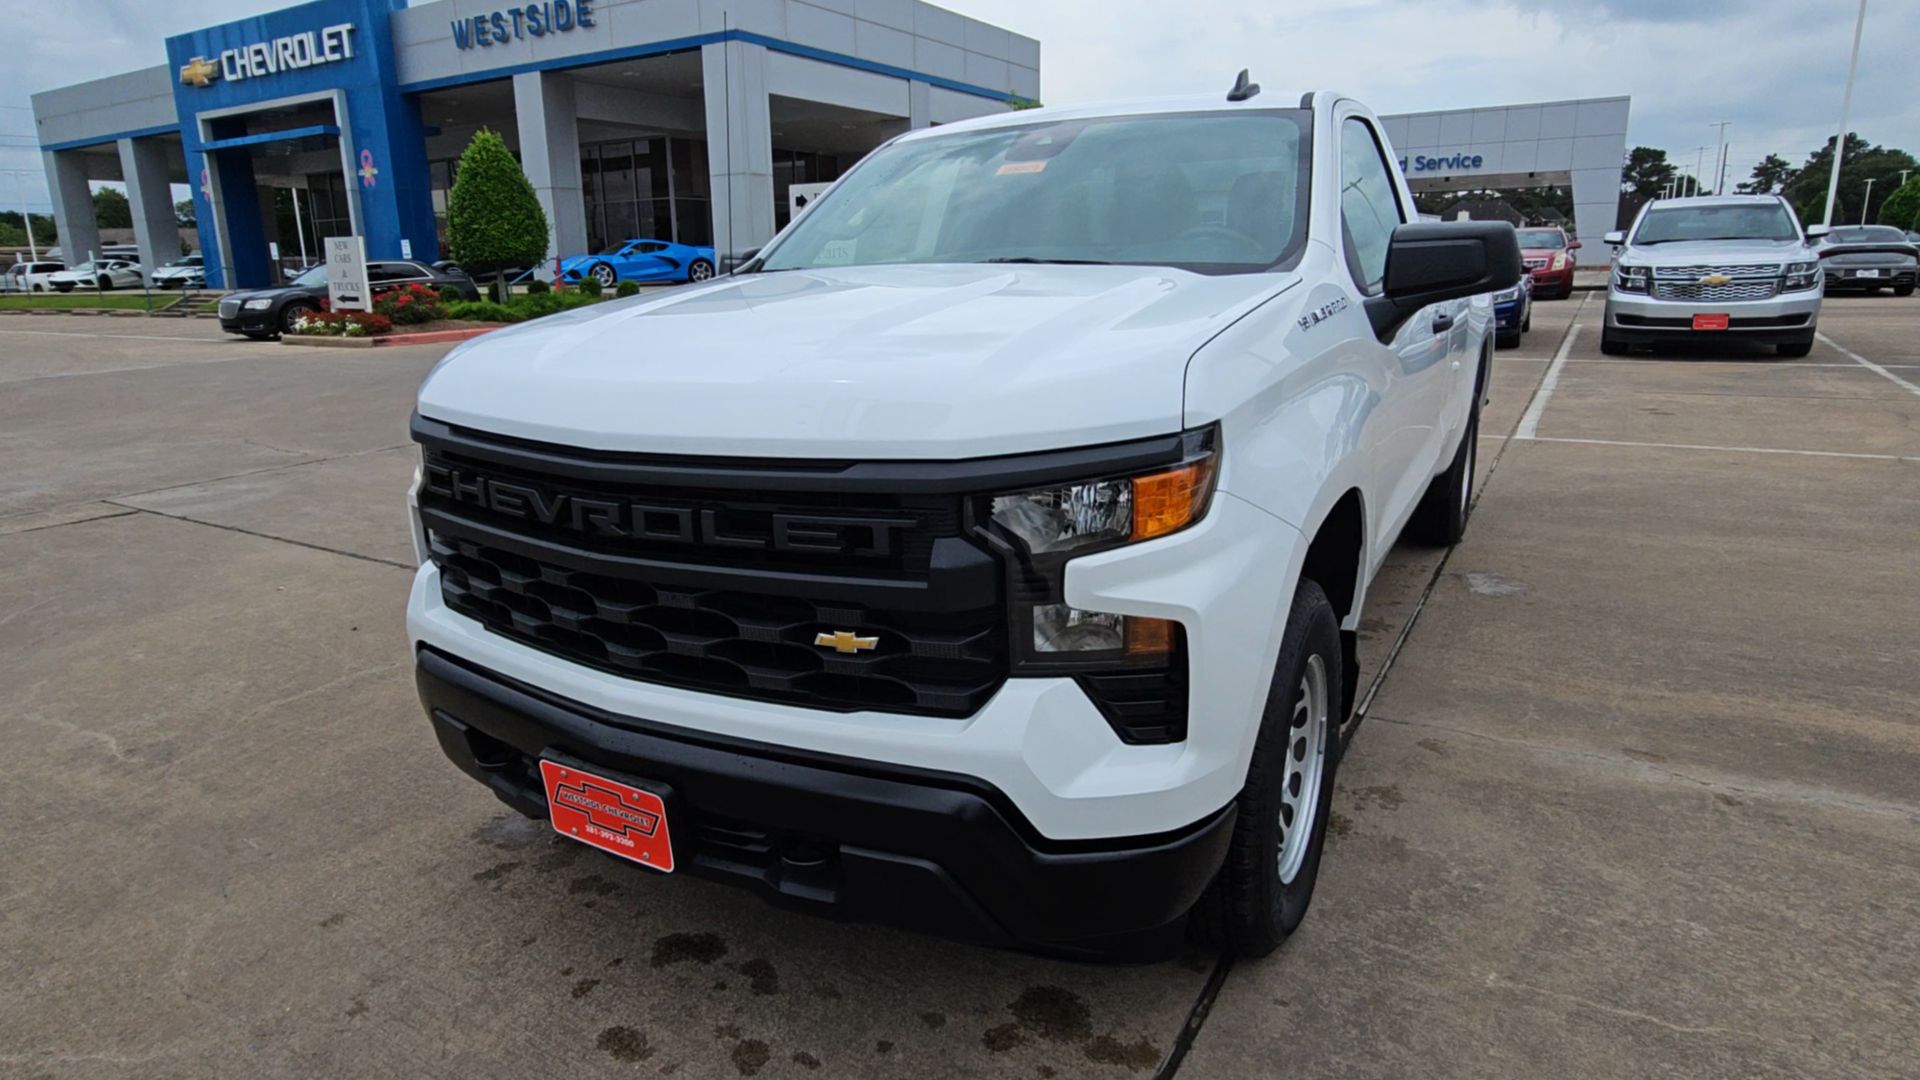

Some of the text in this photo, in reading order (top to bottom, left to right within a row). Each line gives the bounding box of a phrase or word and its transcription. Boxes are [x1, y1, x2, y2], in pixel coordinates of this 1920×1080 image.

[451, 0, 594, 50] WESTSIDE
[221, 23, 353, 81] CHEVROLET
[1415, 153, 1483, 171] Service
[334, 241, 348, 250] NEW
[335, 253, 351, 264] CARS
[333, 282, 360, 292] TRUCKS
[425, 464, 918, 552] CHEVROLET
